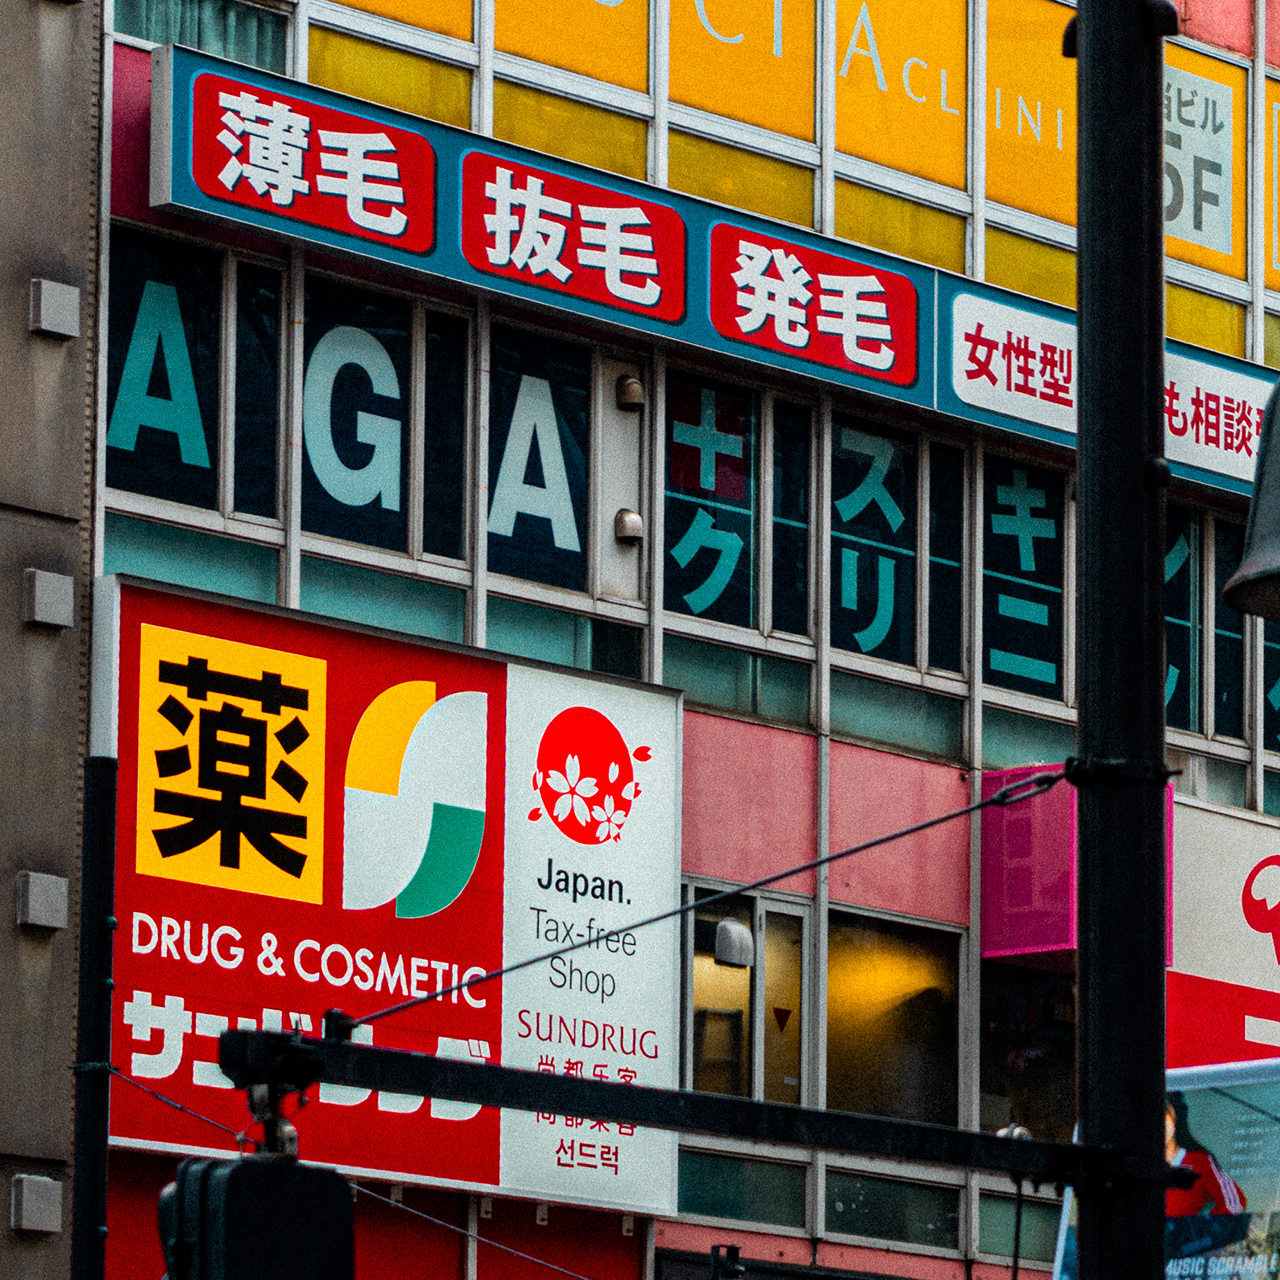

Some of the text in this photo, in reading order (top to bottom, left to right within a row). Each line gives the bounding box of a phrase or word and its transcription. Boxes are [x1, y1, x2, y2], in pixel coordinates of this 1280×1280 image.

[902, 57, 1064, 150] CLINI
[216, 91, 407, 237] 薄毛
[484, 164, 662, 308] 抜毛
[731, 238, 896, 374] 発毛
[106, 279, 582, 553] AGA
[152, 656, 310, 880] 薬
[537, 858, 632, 905] Japan.
[132, 911, 487, 1009] DRUG & COSMETIC
[529, 906, 637, 956] Tax-free
[548, 956, 616, 1003] Shop
[516, 1008, 659, 1060] SUNDRUG
[555, 1138, 619, 1176] 선드럭
